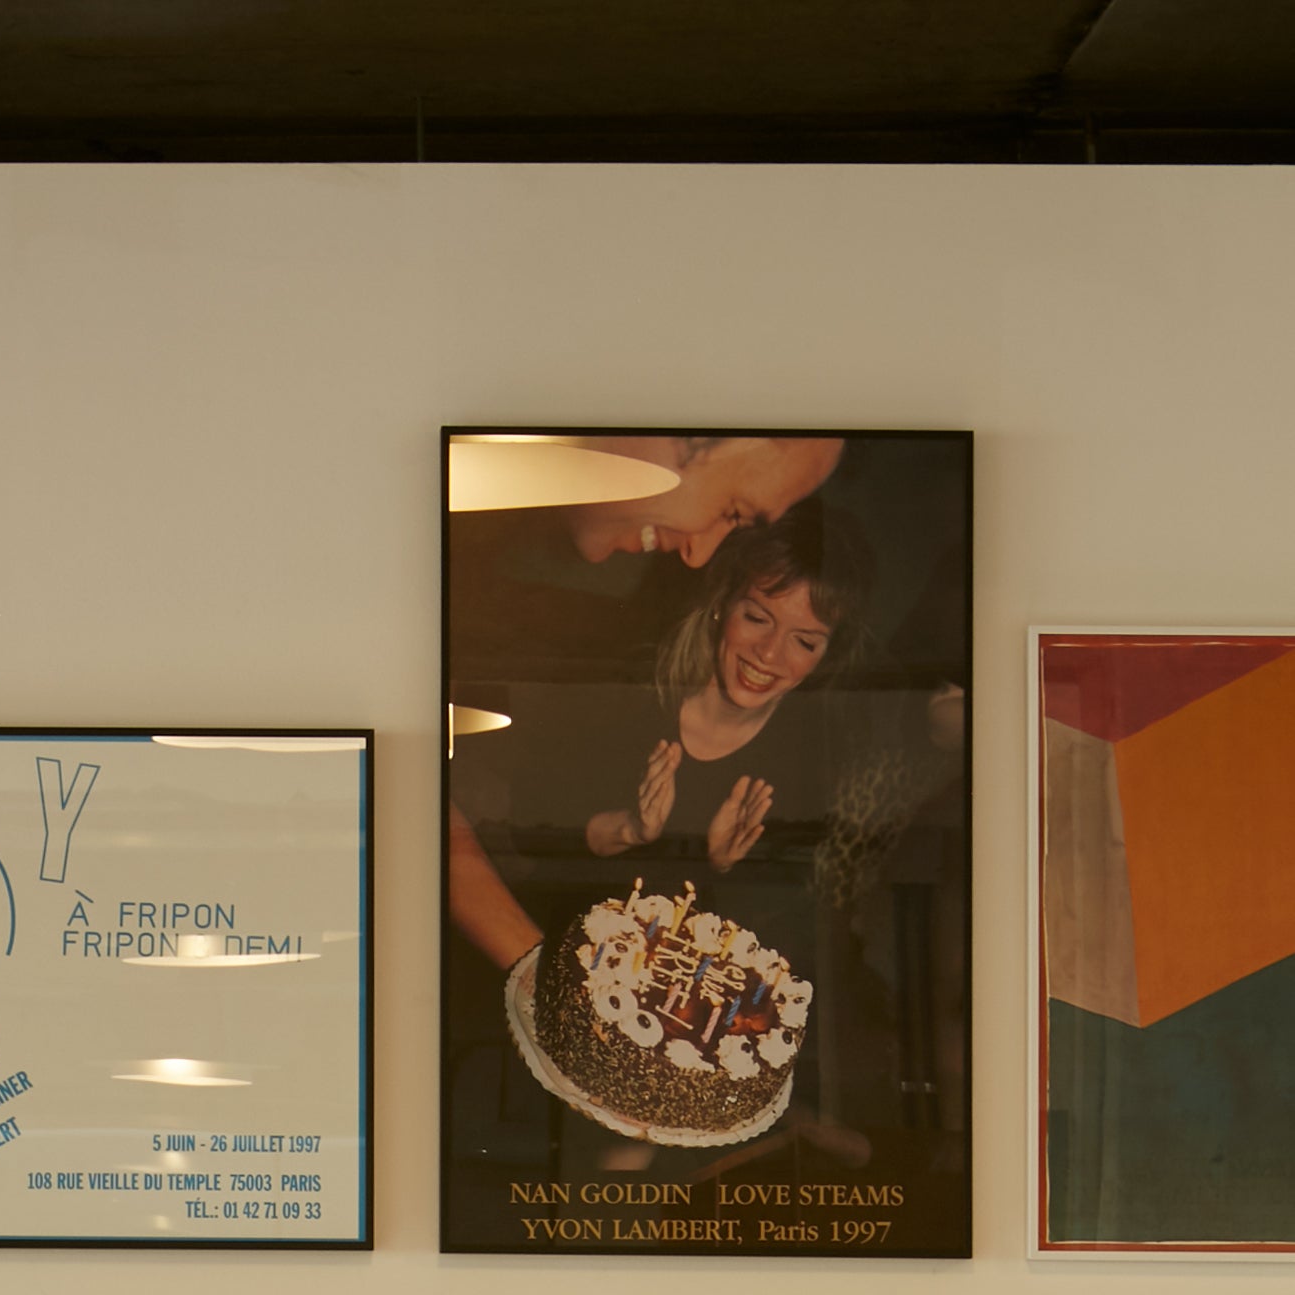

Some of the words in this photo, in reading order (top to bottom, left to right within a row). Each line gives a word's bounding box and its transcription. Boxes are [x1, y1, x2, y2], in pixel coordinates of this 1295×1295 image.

[119, 902, 236, 930] FRIPON
[61, 930, 180, 957] FRIPON
[152, 1135, 162, 1152] 5
[166, 1135, 196, 1153] JUIN
[209, 1135, 228, 1153] 26
[231, 1135, 284, 1153] JUILLET
[289, 1135, 321, 1153] 1997
[27, 1172, 52, 1191] 108
[56, 1172, 84, 1191] RUE
[88, 1172, 139, 1191] VIEILLE
[143, 1173, 163, 1191] DU
[167, 1173, 221, 1192] TEMPLE
[229, 1173, 273, 1193] 75003
[281, 1173, 322, 1193] PARIS
[509, 1183, 572, 1205] NAN
[580, 1183, 693, 1206] GOLDIN
[718, 1184, 792, 1207] LOVE
[798, 1184, 905, 1208] STEAMS
[223, 1202, 239, 1220] 01
[242, 1202, 260, 1220] 42
[263, 1202, 278, 1220] 71
[282, 1202, 301, 1220] 09
[304, 1202, 322, 1220] 33
[521, 1218, 604, 1241] YVON
[612, 1219, 744, 1246] LAMBERT,
[757, 1219, 820, 1243] Paris
[829, 1221, 892, 1244] 1997
